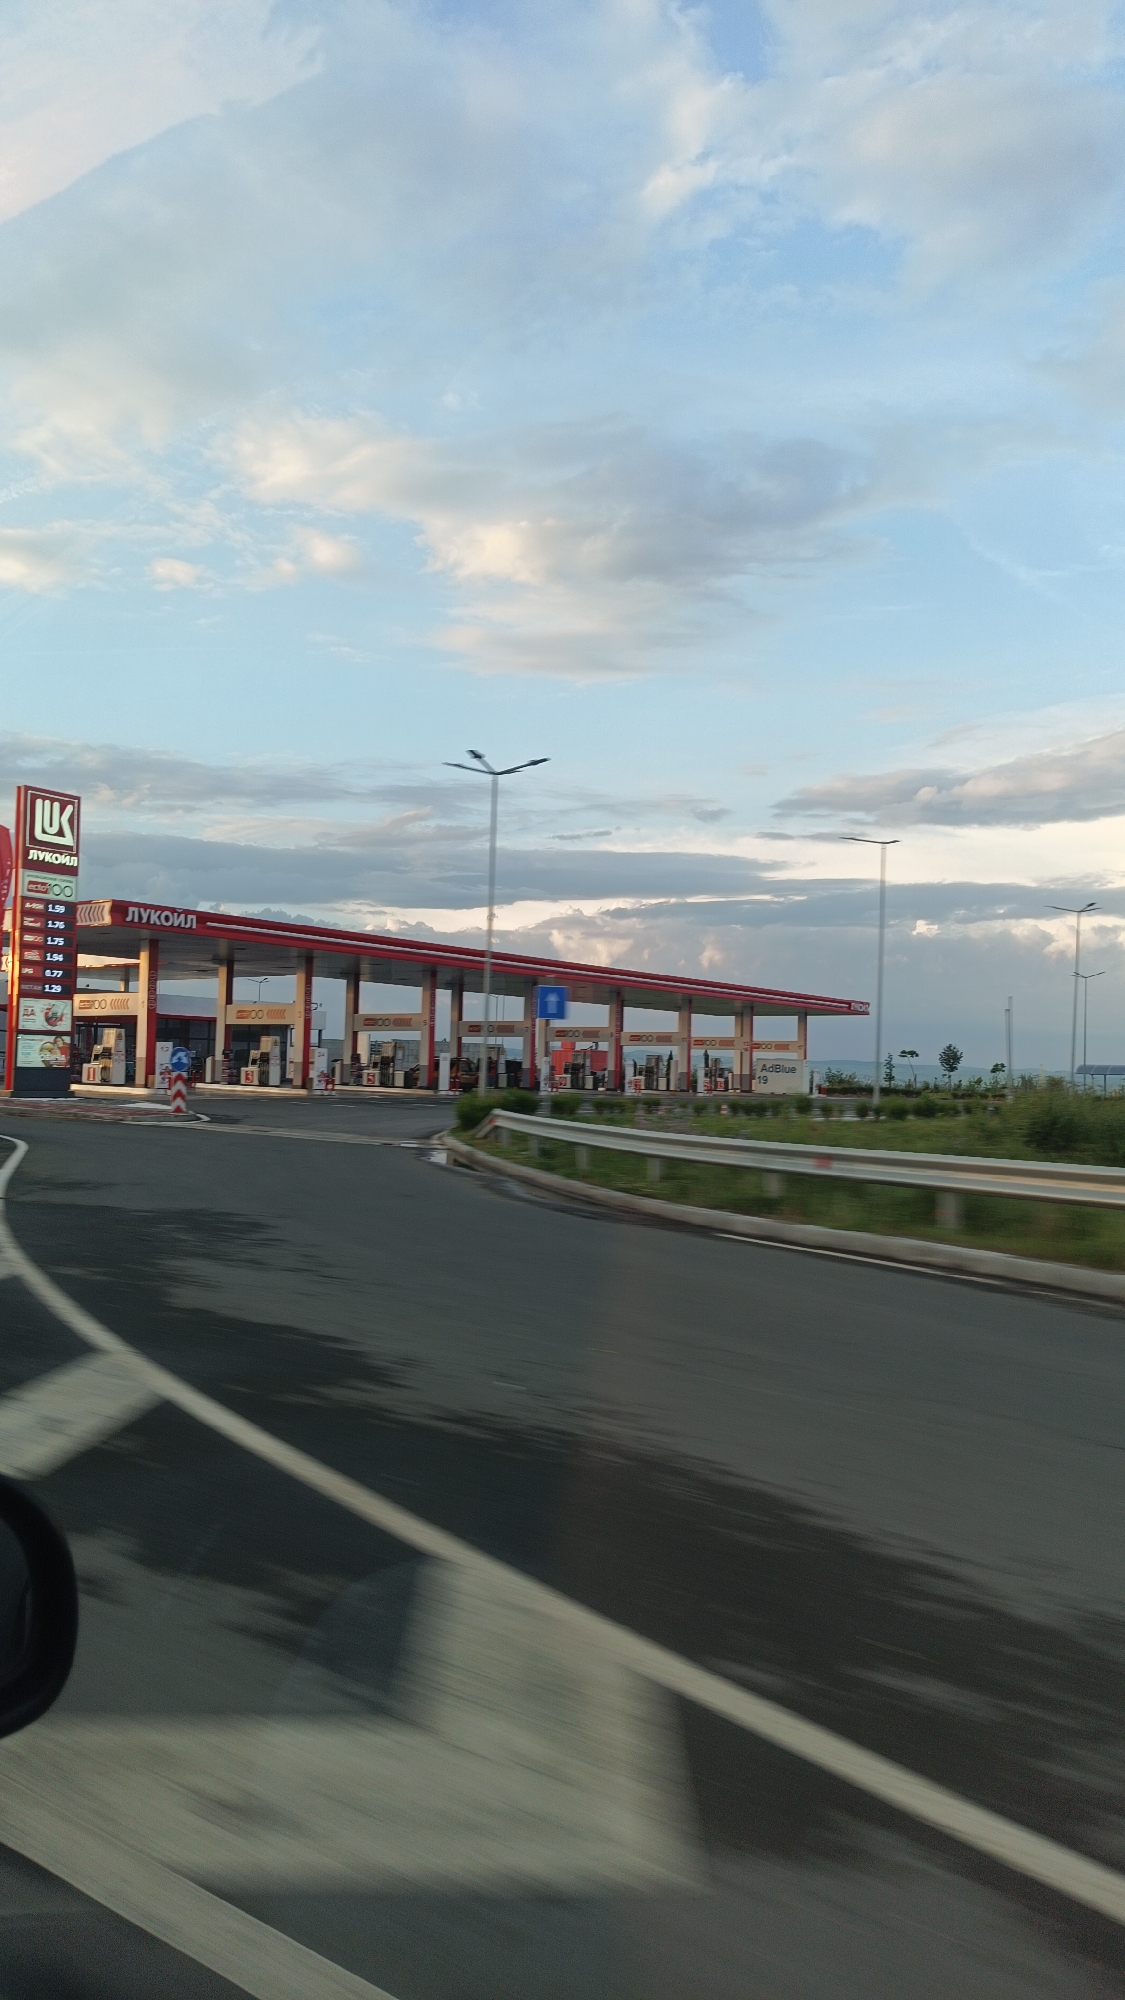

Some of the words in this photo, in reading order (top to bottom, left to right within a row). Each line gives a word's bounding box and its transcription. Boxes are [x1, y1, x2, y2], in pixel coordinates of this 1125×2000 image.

[28, 849, 78, 867] ЛУКОЙЛ
[48, 903, 65, 914] 1.59
[125, 906, 197, 929] ЛУКОЙЛ
[46, 936, 65, 946] 1.75
[44, 984, 62, 993] 1.29
[760, 1063, 797, 1074] AdBlue
[246, 1071, 253, 1083] 3
[757, 1075, 768, 1085] 19
